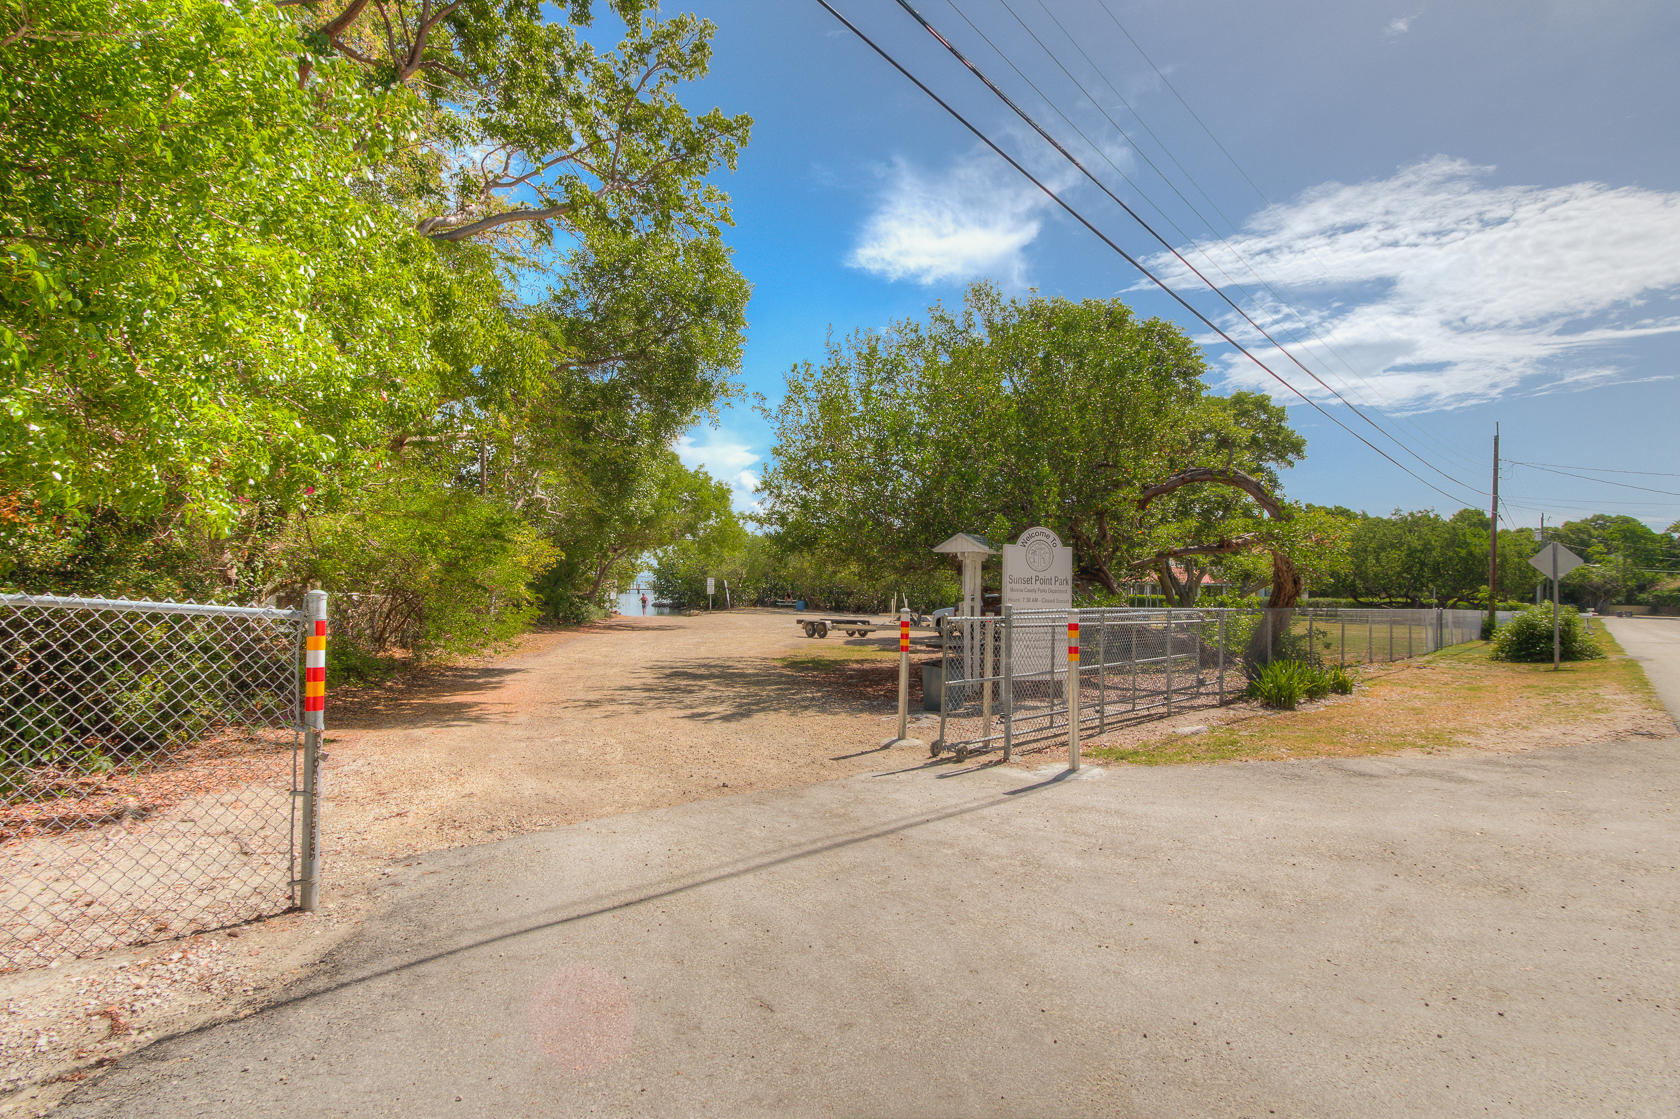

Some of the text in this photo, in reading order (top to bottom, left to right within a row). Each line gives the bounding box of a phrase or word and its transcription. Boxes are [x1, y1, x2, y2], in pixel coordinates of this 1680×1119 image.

[1020, 531, 1058, 548] Welcome To
[1008, 574, 1069, 587] Sunset Point Park
